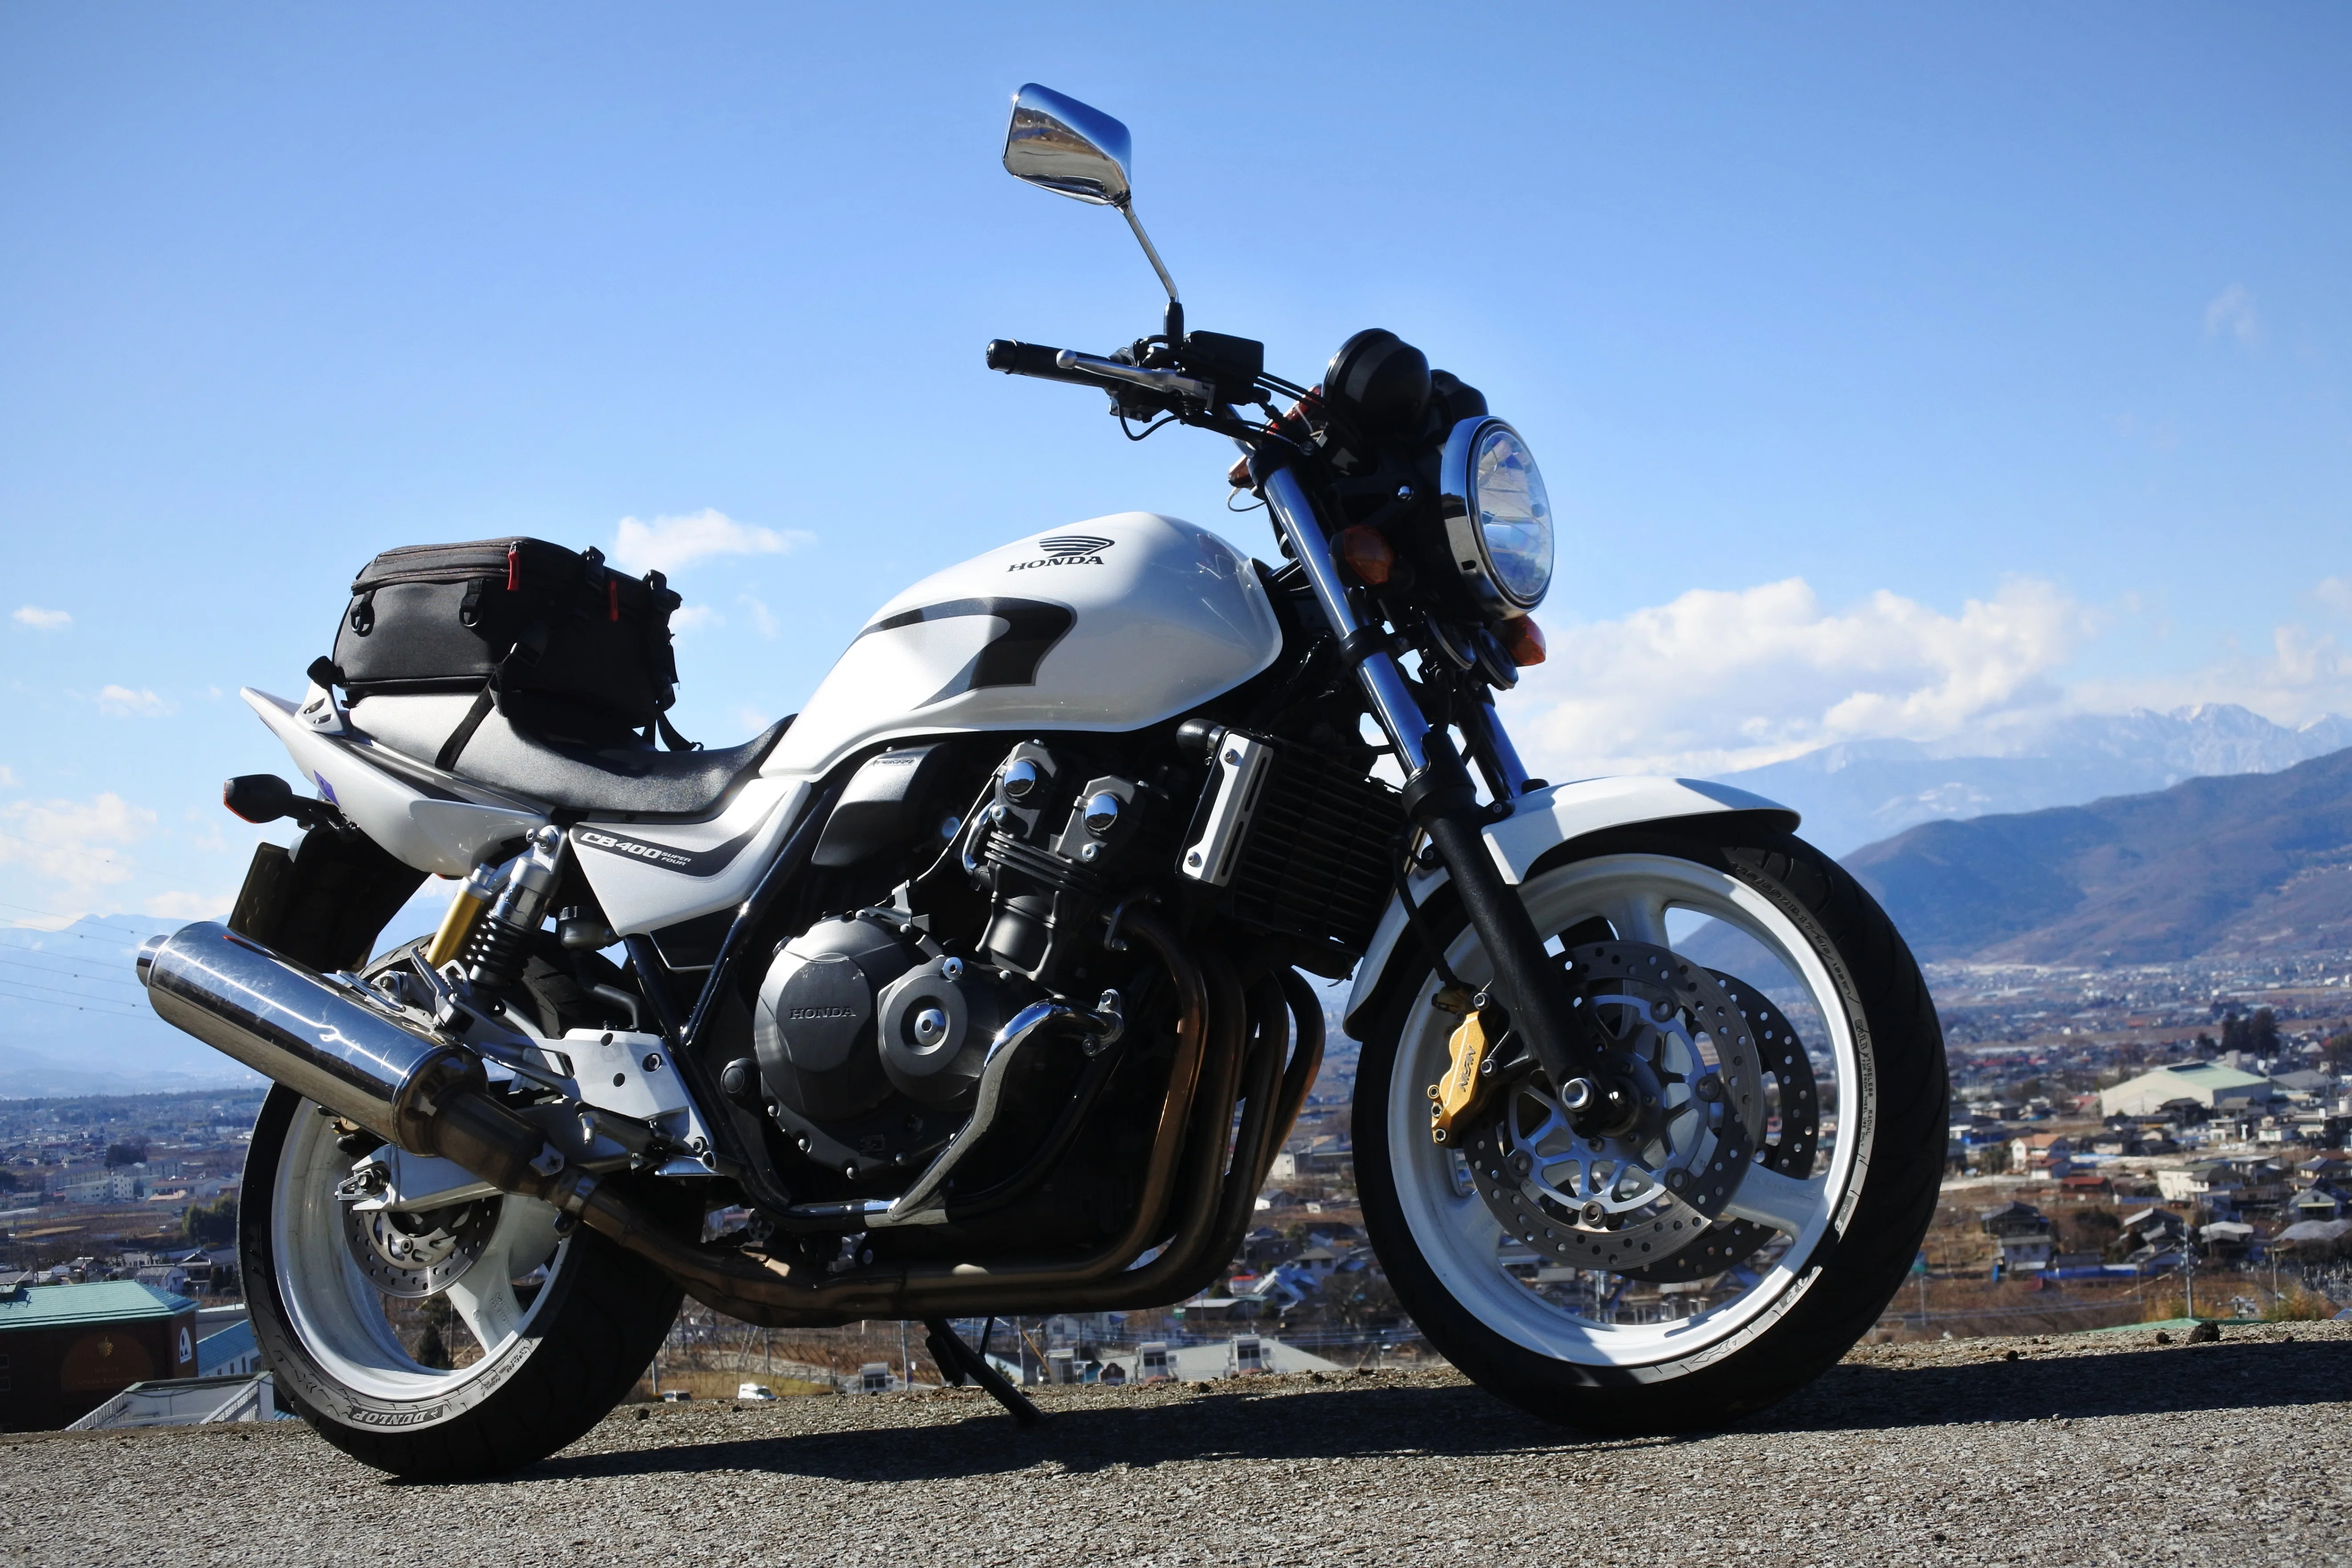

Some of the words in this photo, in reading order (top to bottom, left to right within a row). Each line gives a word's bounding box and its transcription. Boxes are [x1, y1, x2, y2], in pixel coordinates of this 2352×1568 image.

[1006, 556, 1105, 572] HONDA
[580, 832, 662, 859] CB400
[661, 852, 691, 862] SUPER
[661, 856, 686, 866] FOUR
[789, 1006, 856, 1020] HONDA
[352, 1411, 428, 1425] DUNLOP
